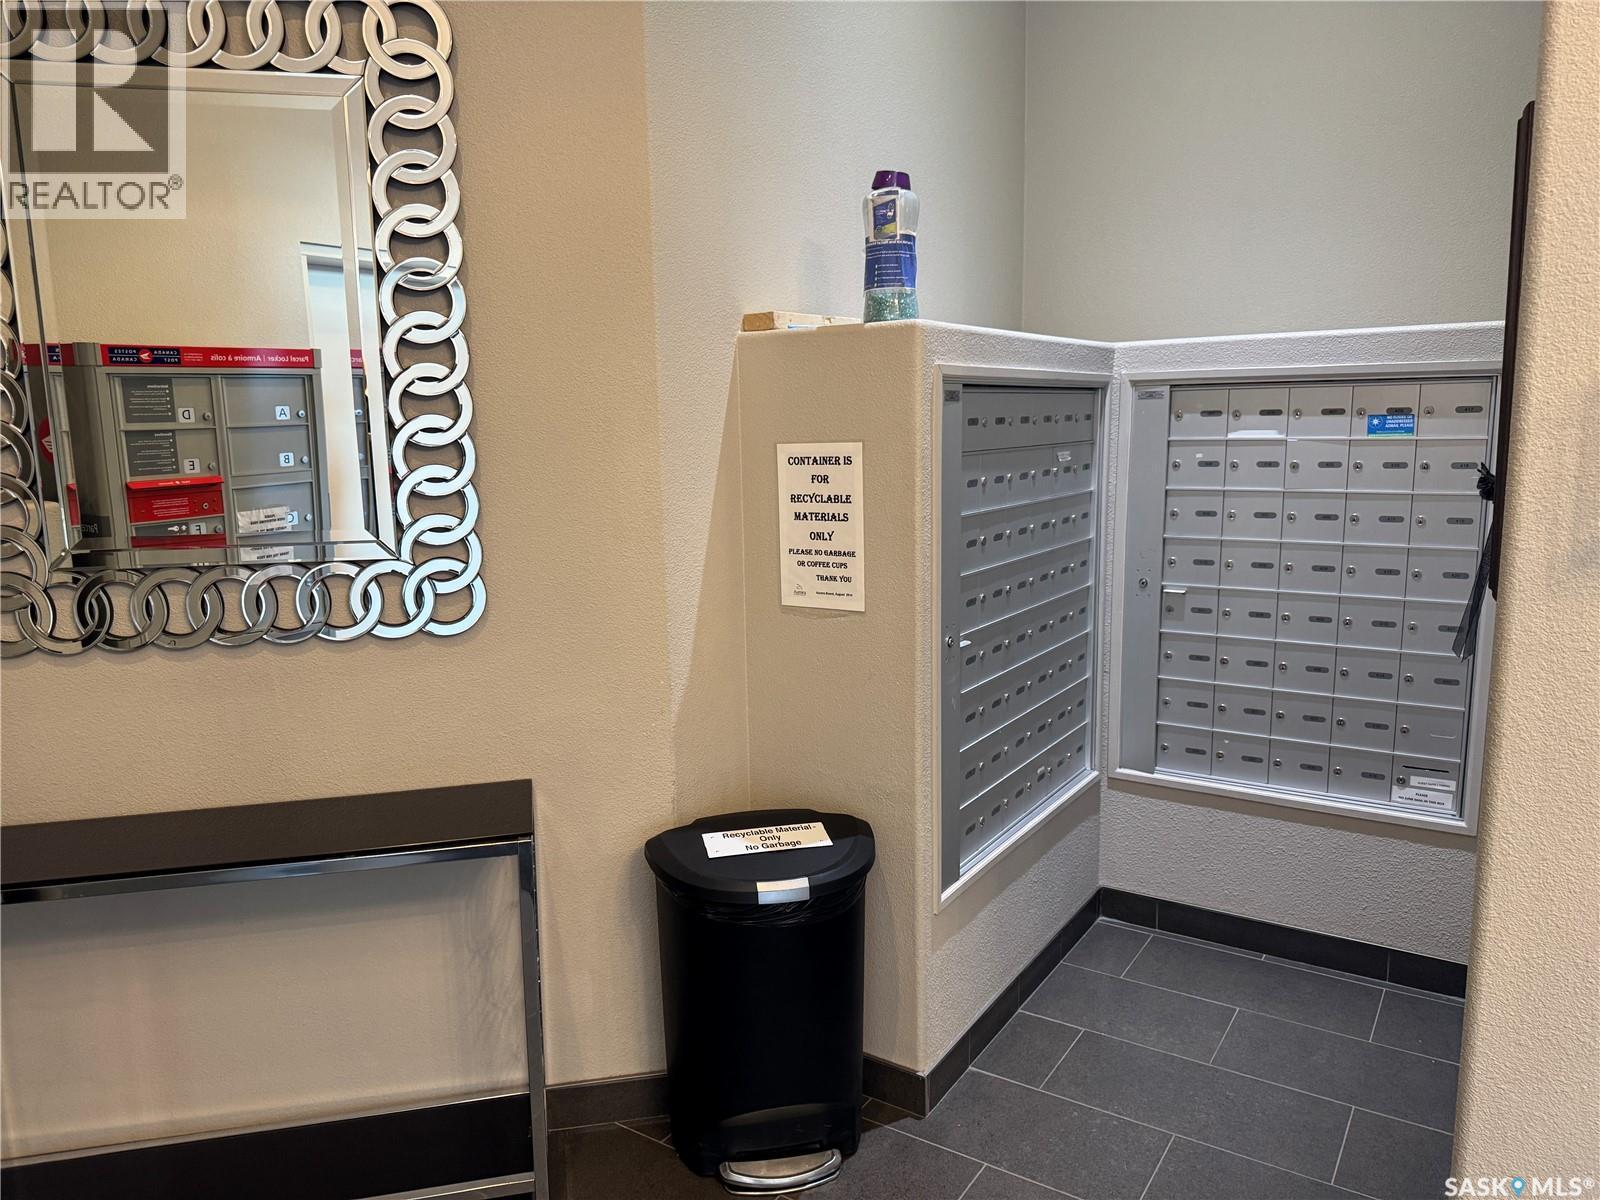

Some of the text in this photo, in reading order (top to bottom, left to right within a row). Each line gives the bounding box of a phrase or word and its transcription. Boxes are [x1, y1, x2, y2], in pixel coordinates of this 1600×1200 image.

[788, 456, 852, 465] CONTAINER IS
[811, 475, 829, 484] FOR
[790, 493, 852, 503] RECYCLABLE
[794, 512, 849, 521] MATERIALS
[810, 531, 834, 541] ONLY
[722, 824, 812, 839] Recyclable Material
[762, 840, 802, 849] Garbage
